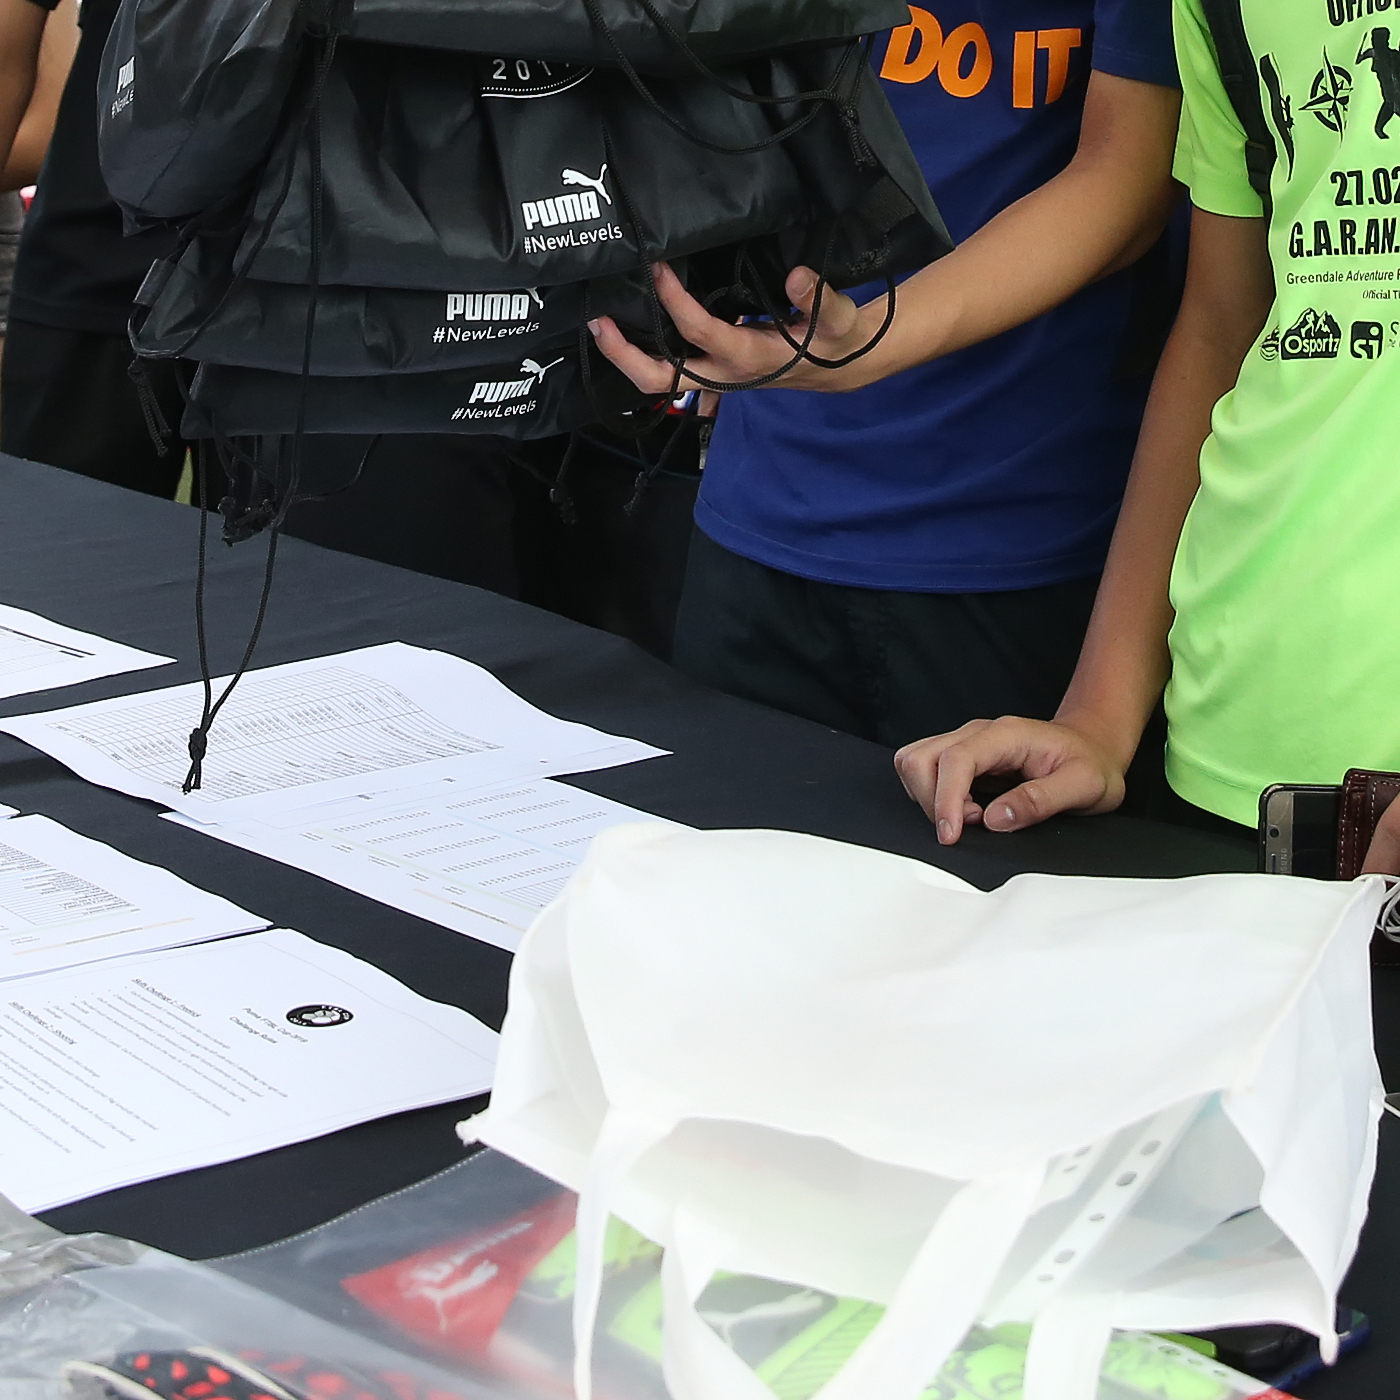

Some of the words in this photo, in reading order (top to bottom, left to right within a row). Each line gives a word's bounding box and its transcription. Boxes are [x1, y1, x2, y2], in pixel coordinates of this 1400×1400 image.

[879, 4, 994, 98] DO
[1012, 27, 1082, 109] IT
[521, 190, 602, 231] PUMA
[523, 222, 623, 254] #NewLevels
[1286, 270, 1344, 285] Greendale
[1345, 269, 1394, 282] Adventure
[446, 292, 530, 322] PUMA
[1362, 289, 1391, 300] Official
[432, 321, 540, 344] #NewLevels
[1284, 332, 1340, 357] Osportz
[468, 375, 536, 404] PUMA
[450, 399, 537, 421] #NewLevels
